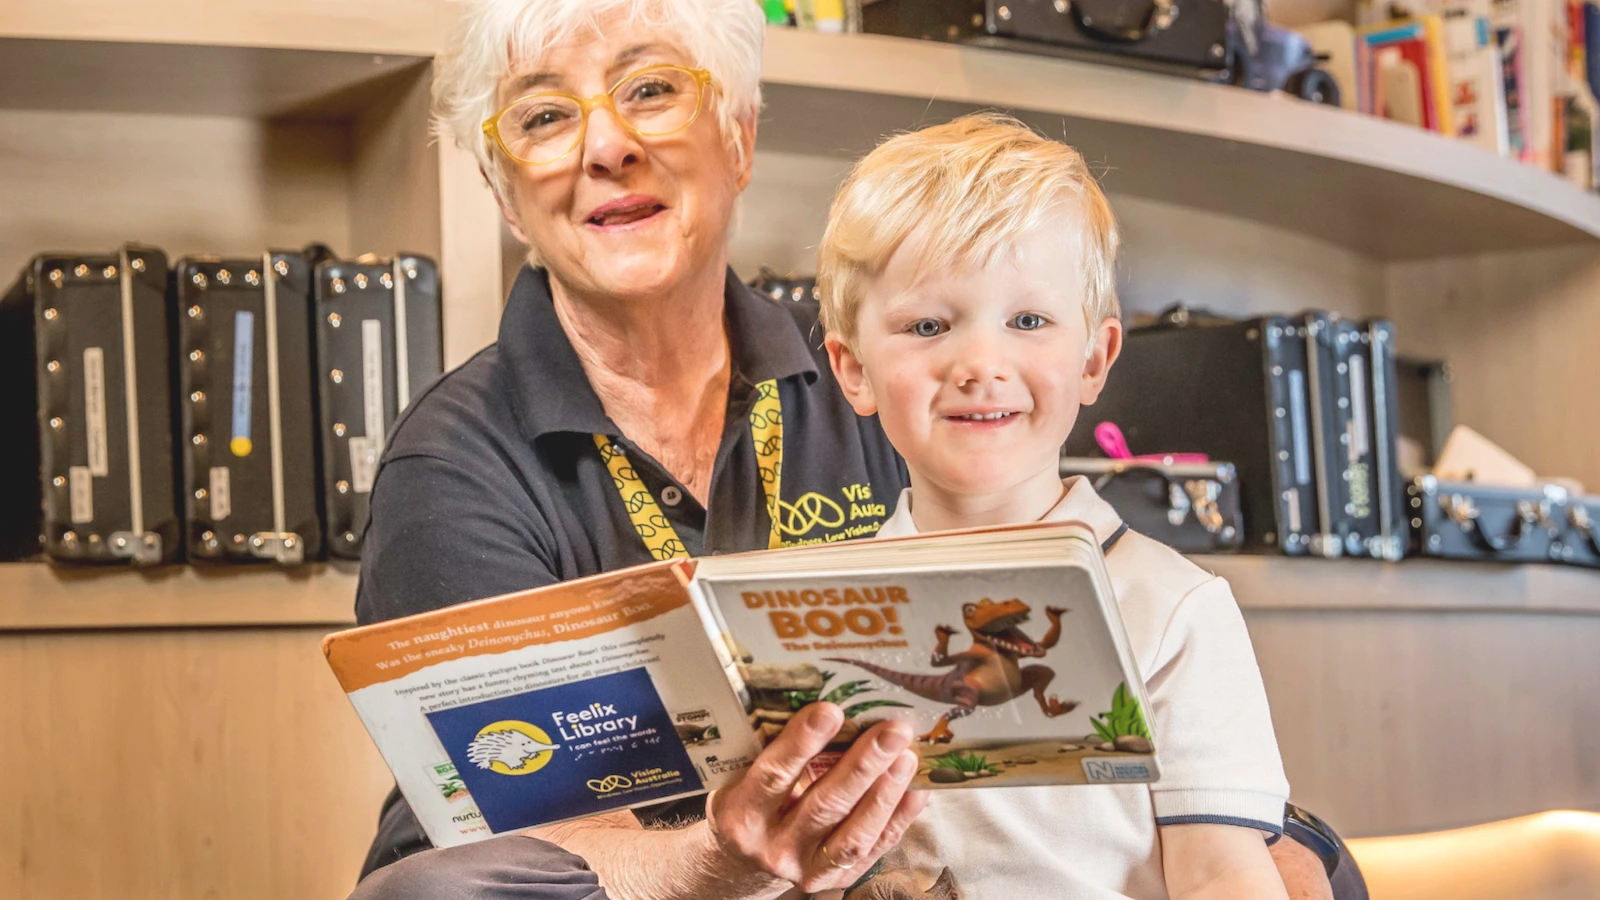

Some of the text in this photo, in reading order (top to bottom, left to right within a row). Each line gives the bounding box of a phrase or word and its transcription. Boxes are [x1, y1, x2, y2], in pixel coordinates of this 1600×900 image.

[842, 483, 872, 502] Vis
[825, 533, 845, 543] Low
[740, 586, 911, 609] DINOSAUR
[387, 639, 411, 650] The
[413, 621, 490, 645] naughtiest
[493, 614, 547, 630] dinosaur
[549, 602, 592, 620] anyone
[768, 606, 903, 639] BOO!
[376, 602, 654, 670] Was the sneaky Deinonychus, Dinosaur Boo.
[781, 642, 810, 651] The
[394, 683, 430, 695] Inspired
[444, 678, 458, 686] the
[460, 673, 486, 682] classic
[488, 666, 518, 677] picture
[519, 660, 540, 669] book
[542, 653, 575, 664] Dinosaur
[601, 644, 617, 652] this
[619, 633, 665, 648] completely
[428, 699, 458, 711] perfect
[458, 688, 512, 703] introduction
[524, 677, 565, 690] dinosaurs
[594, 665, 620, 675] young
[438, 689, 459, 698] story
[484, 678, 512, 688] funny,
[512, 670, 549, 681] rhyming
[551, 665, 567, 673] text
[569, 659, 593, 670] about
[552, 702, 617, 727] Feelix
[559, 715, 638, 741] Library
[574, 742, 592, 751] can
[593, 737, 611, 747] feel
[612, 733, 628, 743] the
[629, 728, 657, 739] words
[631, 767, 662, 779] Vision
[635, 770, 680, 785] Australia
[711, 766, 727, 774] UK
[452, 811, 482, 823] nurtu
[459, 825, 489, 835] www.
